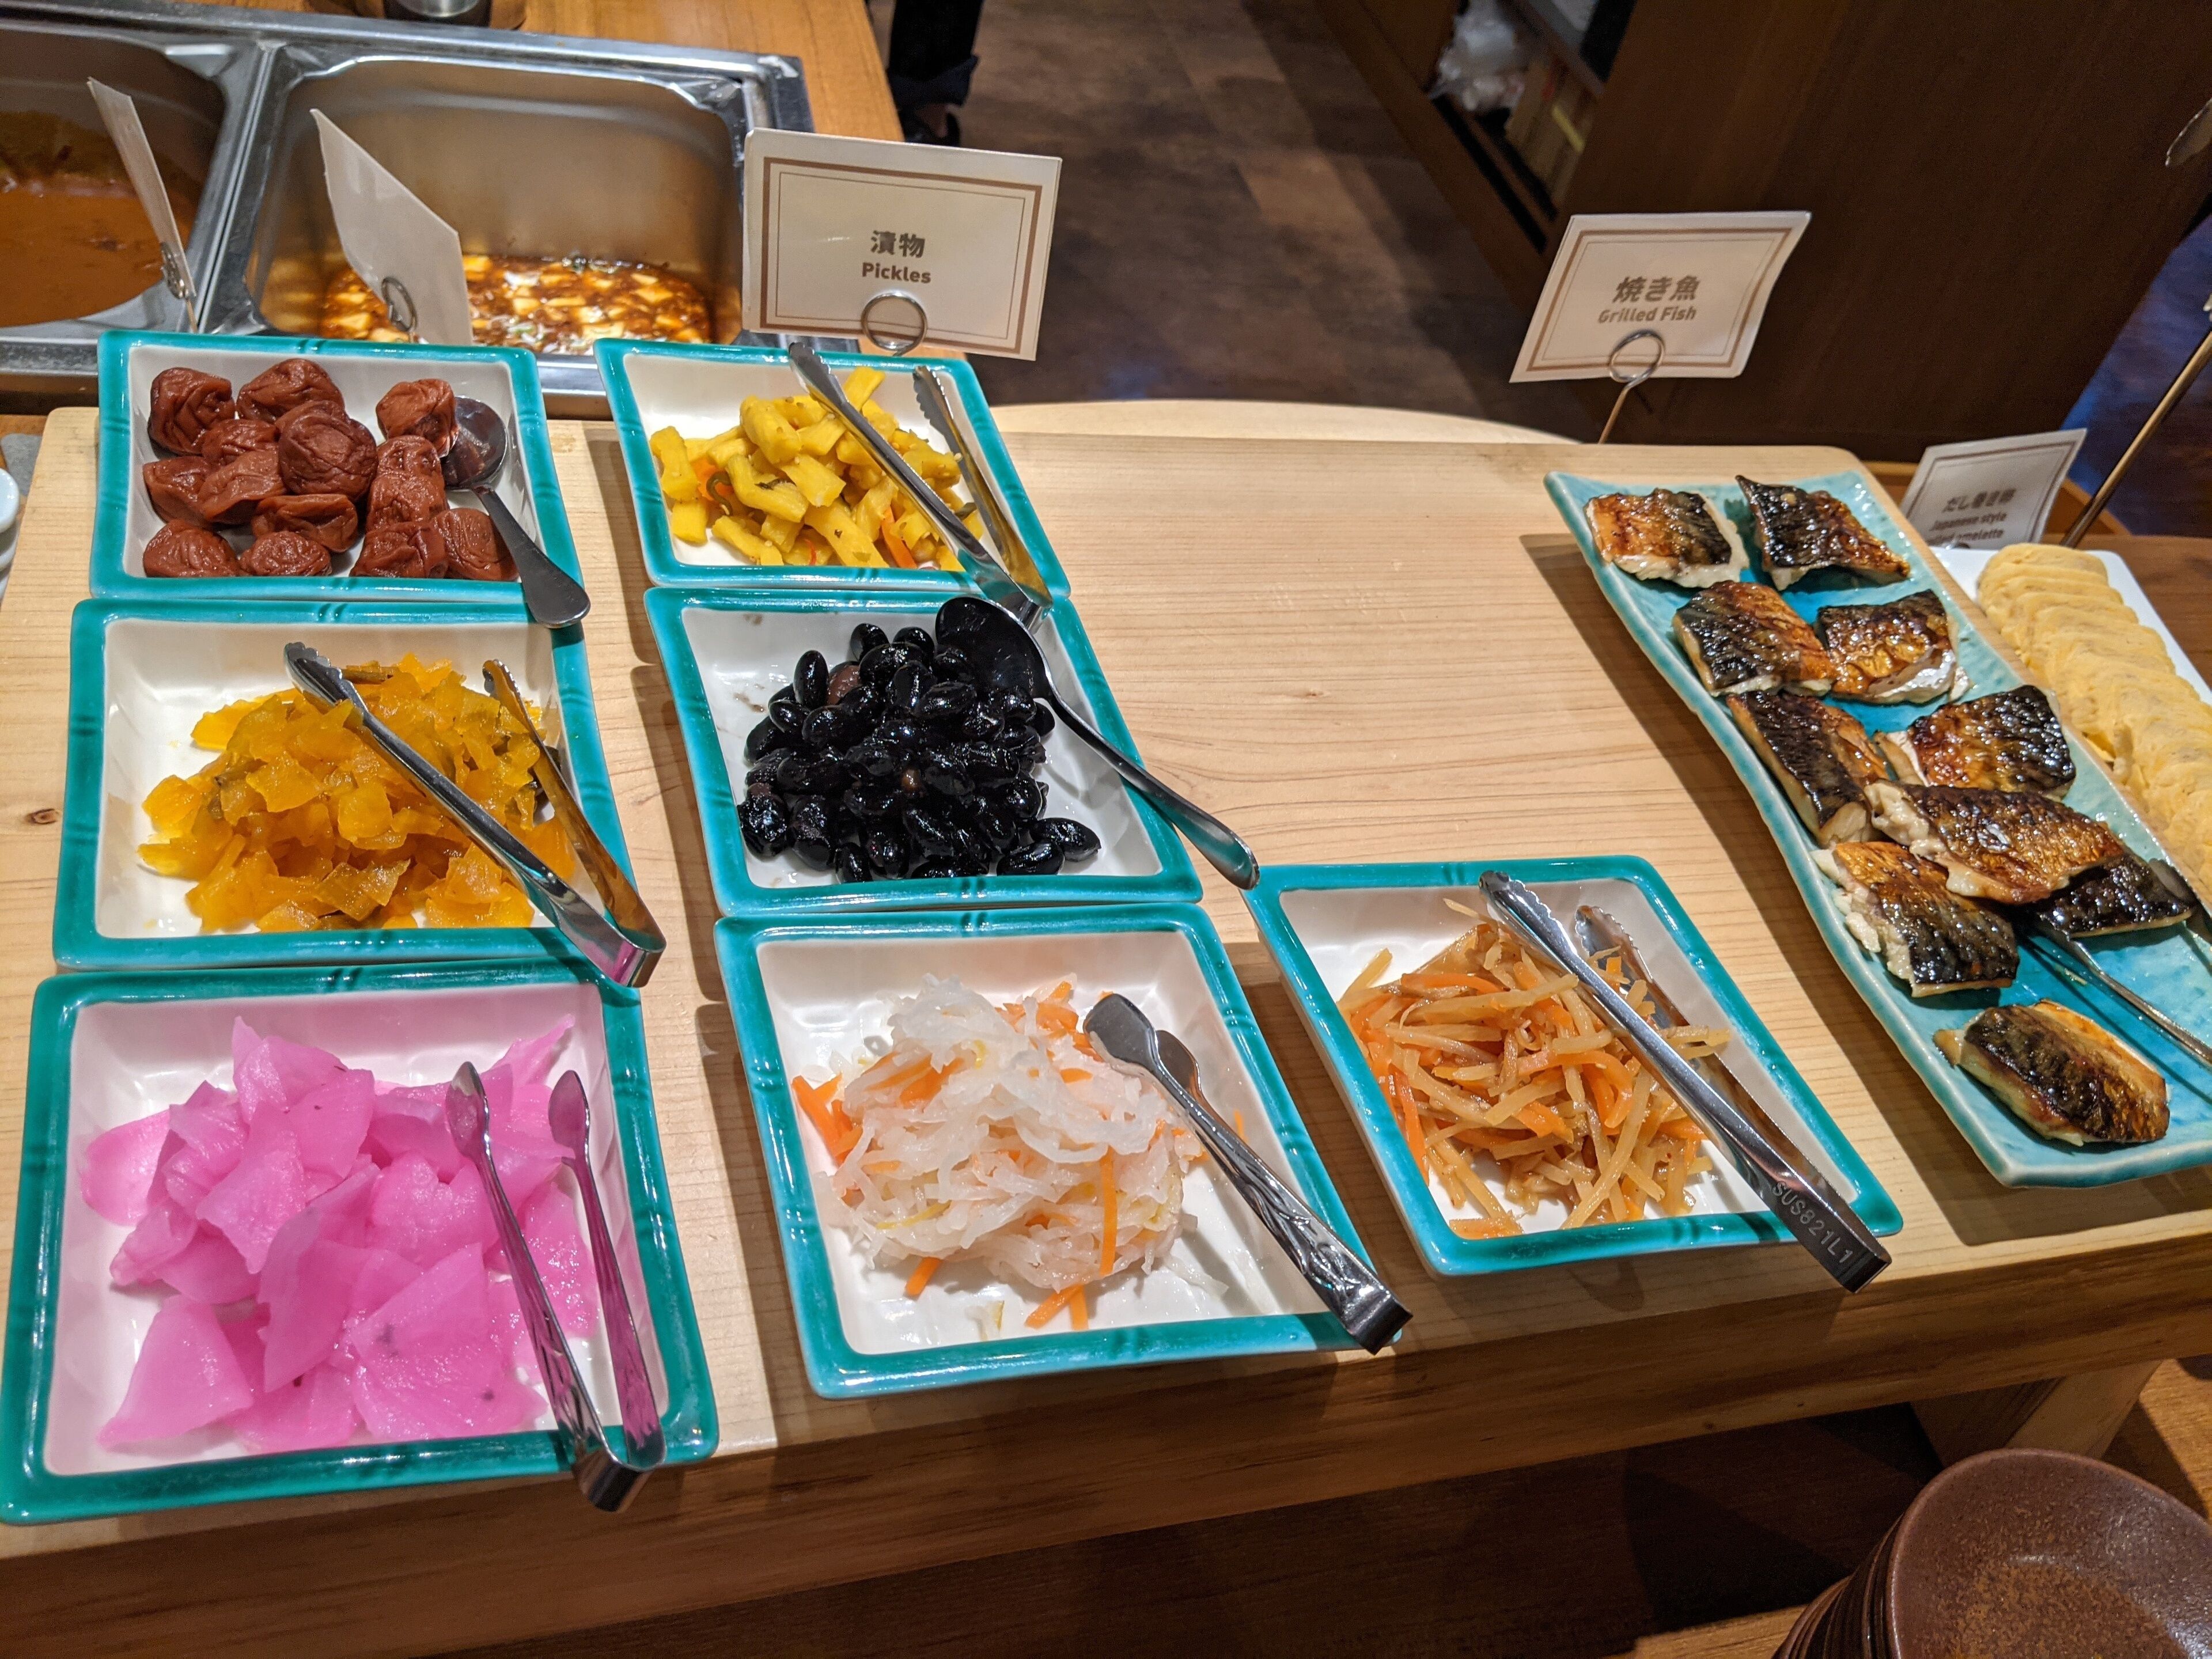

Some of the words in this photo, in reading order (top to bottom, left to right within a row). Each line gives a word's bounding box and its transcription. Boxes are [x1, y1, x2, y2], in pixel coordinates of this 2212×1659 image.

[870, 230, 926, 258] 漬物
[862, 262, 931, 283] Pickles
[1612, 275, 1700, 303] 焼き魚
[1598, 308, 1658, 324] Grilled
[1660, 306, 1697, 321] Fish
[1771, 1181, 1853, 1263] SUS821L1
